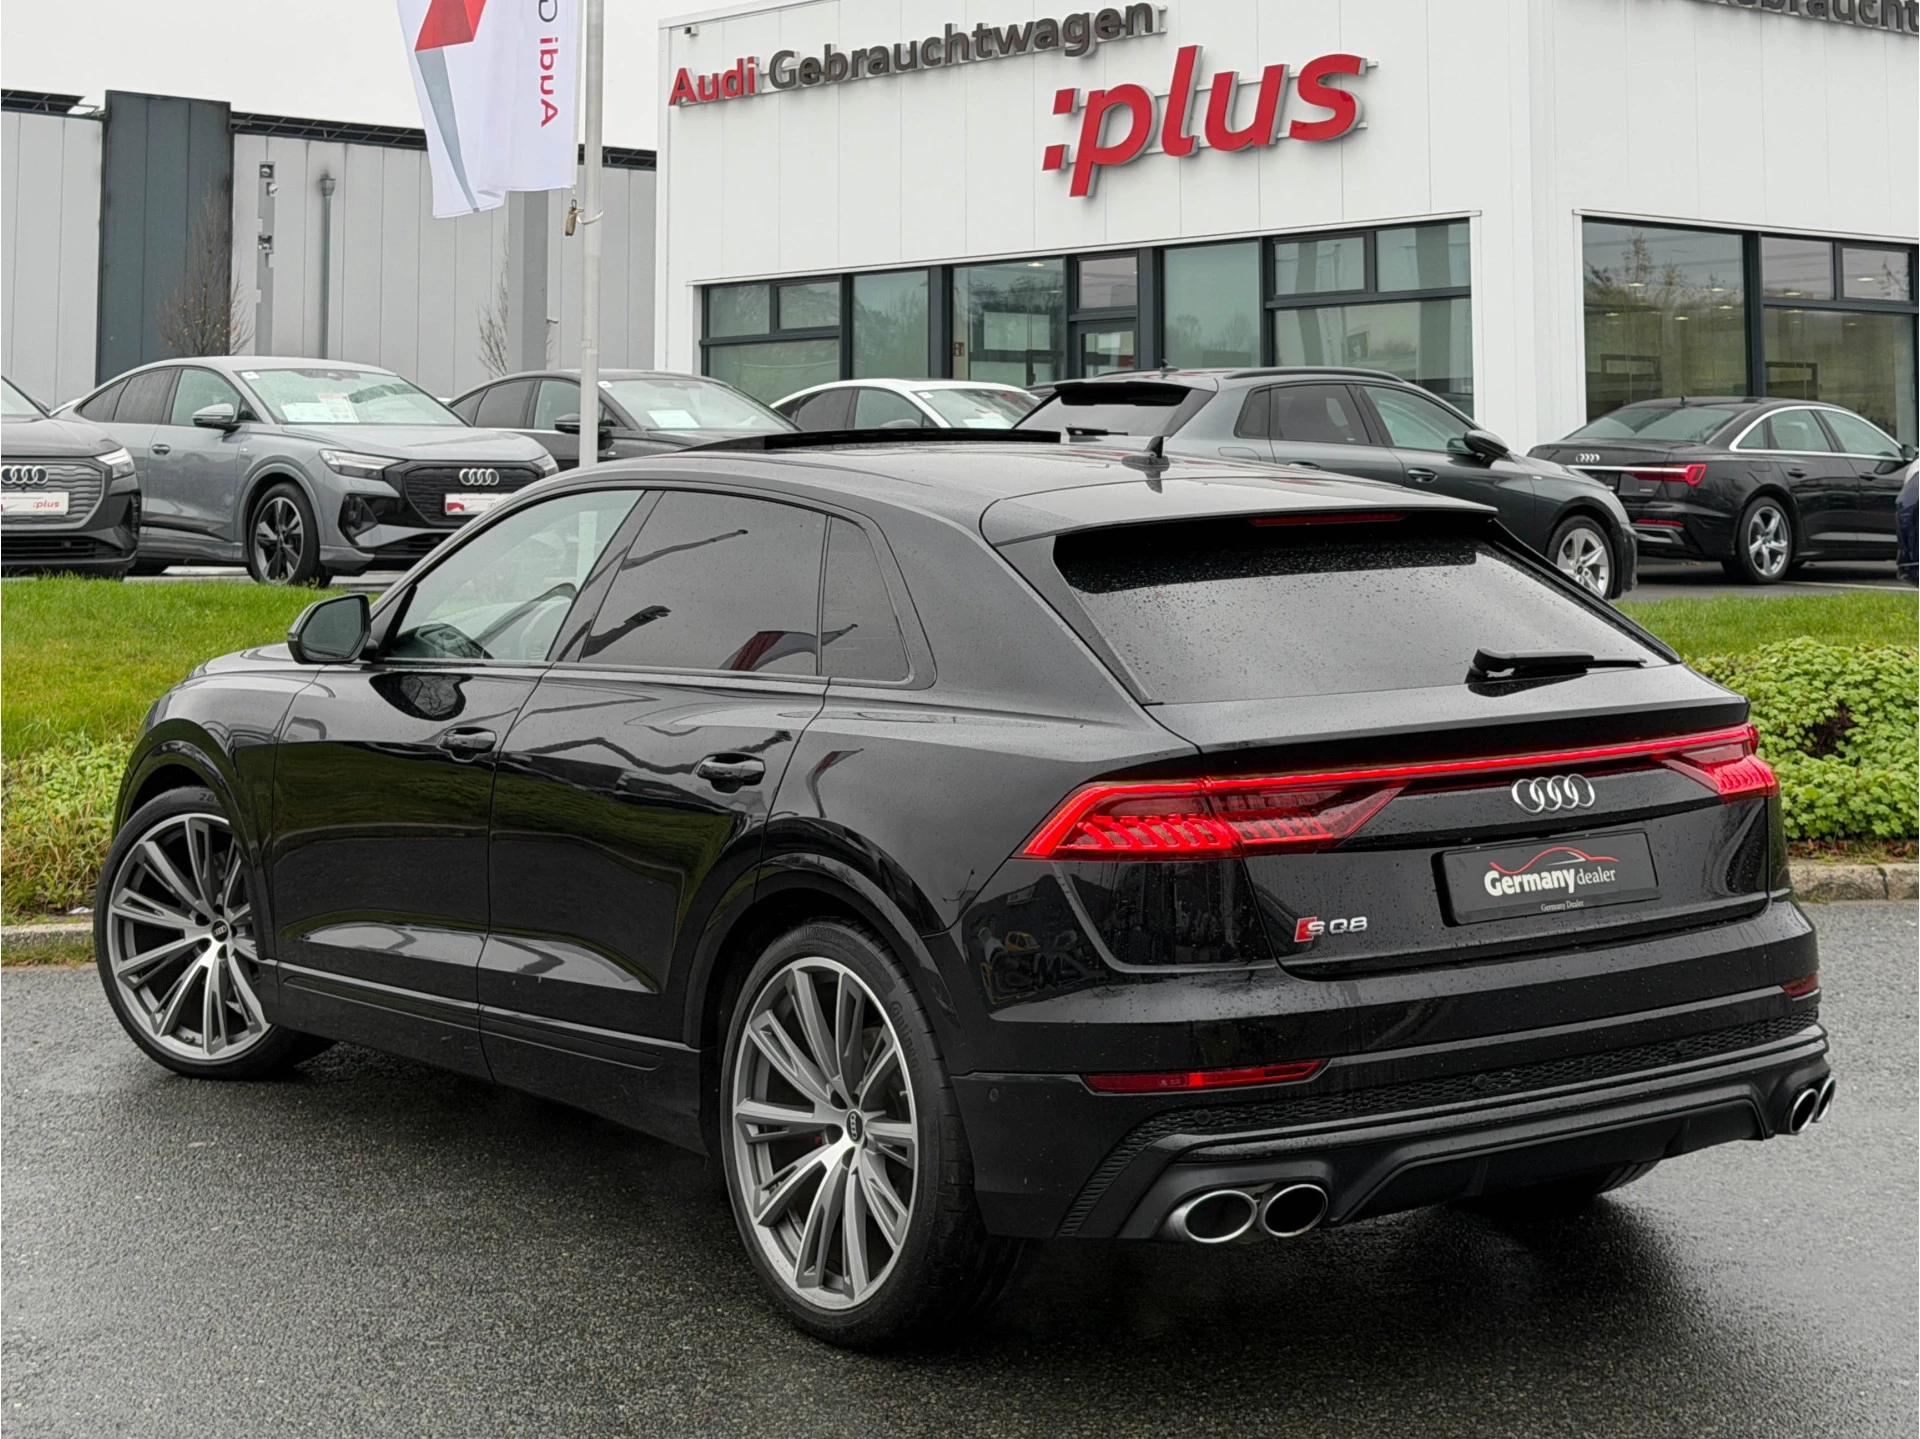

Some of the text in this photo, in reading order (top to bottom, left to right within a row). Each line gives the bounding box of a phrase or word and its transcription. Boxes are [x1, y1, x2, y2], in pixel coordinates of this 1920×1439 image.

[668, 2, 1155, 106] Audi Gebrauchtwagen
[1043, 45, 1364, 197] :plus
[1484, 866, 1617, 896] Germany dealer
